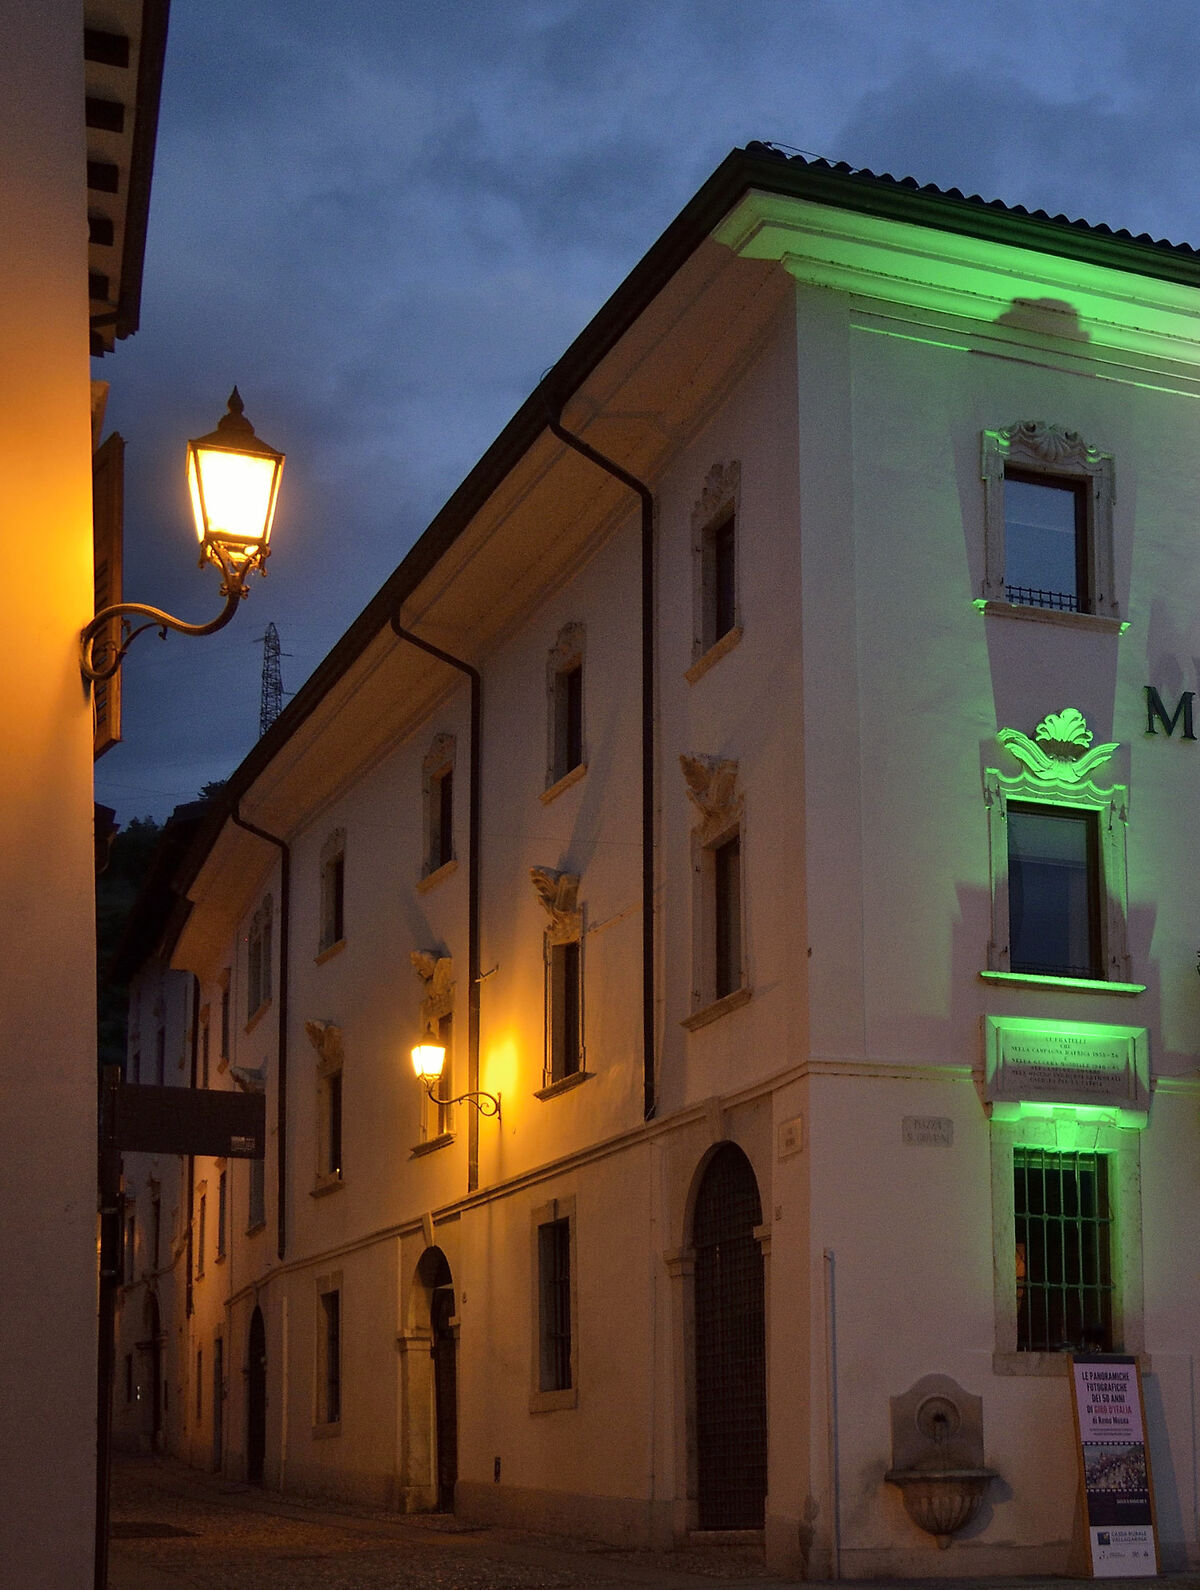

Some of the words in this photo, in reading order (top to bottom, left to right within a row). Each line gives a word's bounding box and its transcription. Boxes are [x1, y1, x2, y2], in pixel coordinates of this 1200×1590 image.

[1082, 1371, 1089, 1380] LE
[1090, 1371, 1129, 1381] PANORAMICHE
[1087, 1383, 1127, 1392] FOTOGRAFICHE
[1091, 1394, 1101, 1403] DEI
[1111, 1394, 1125, 1403] ANNI
[1086, 1405, 1093, 1414] DI
